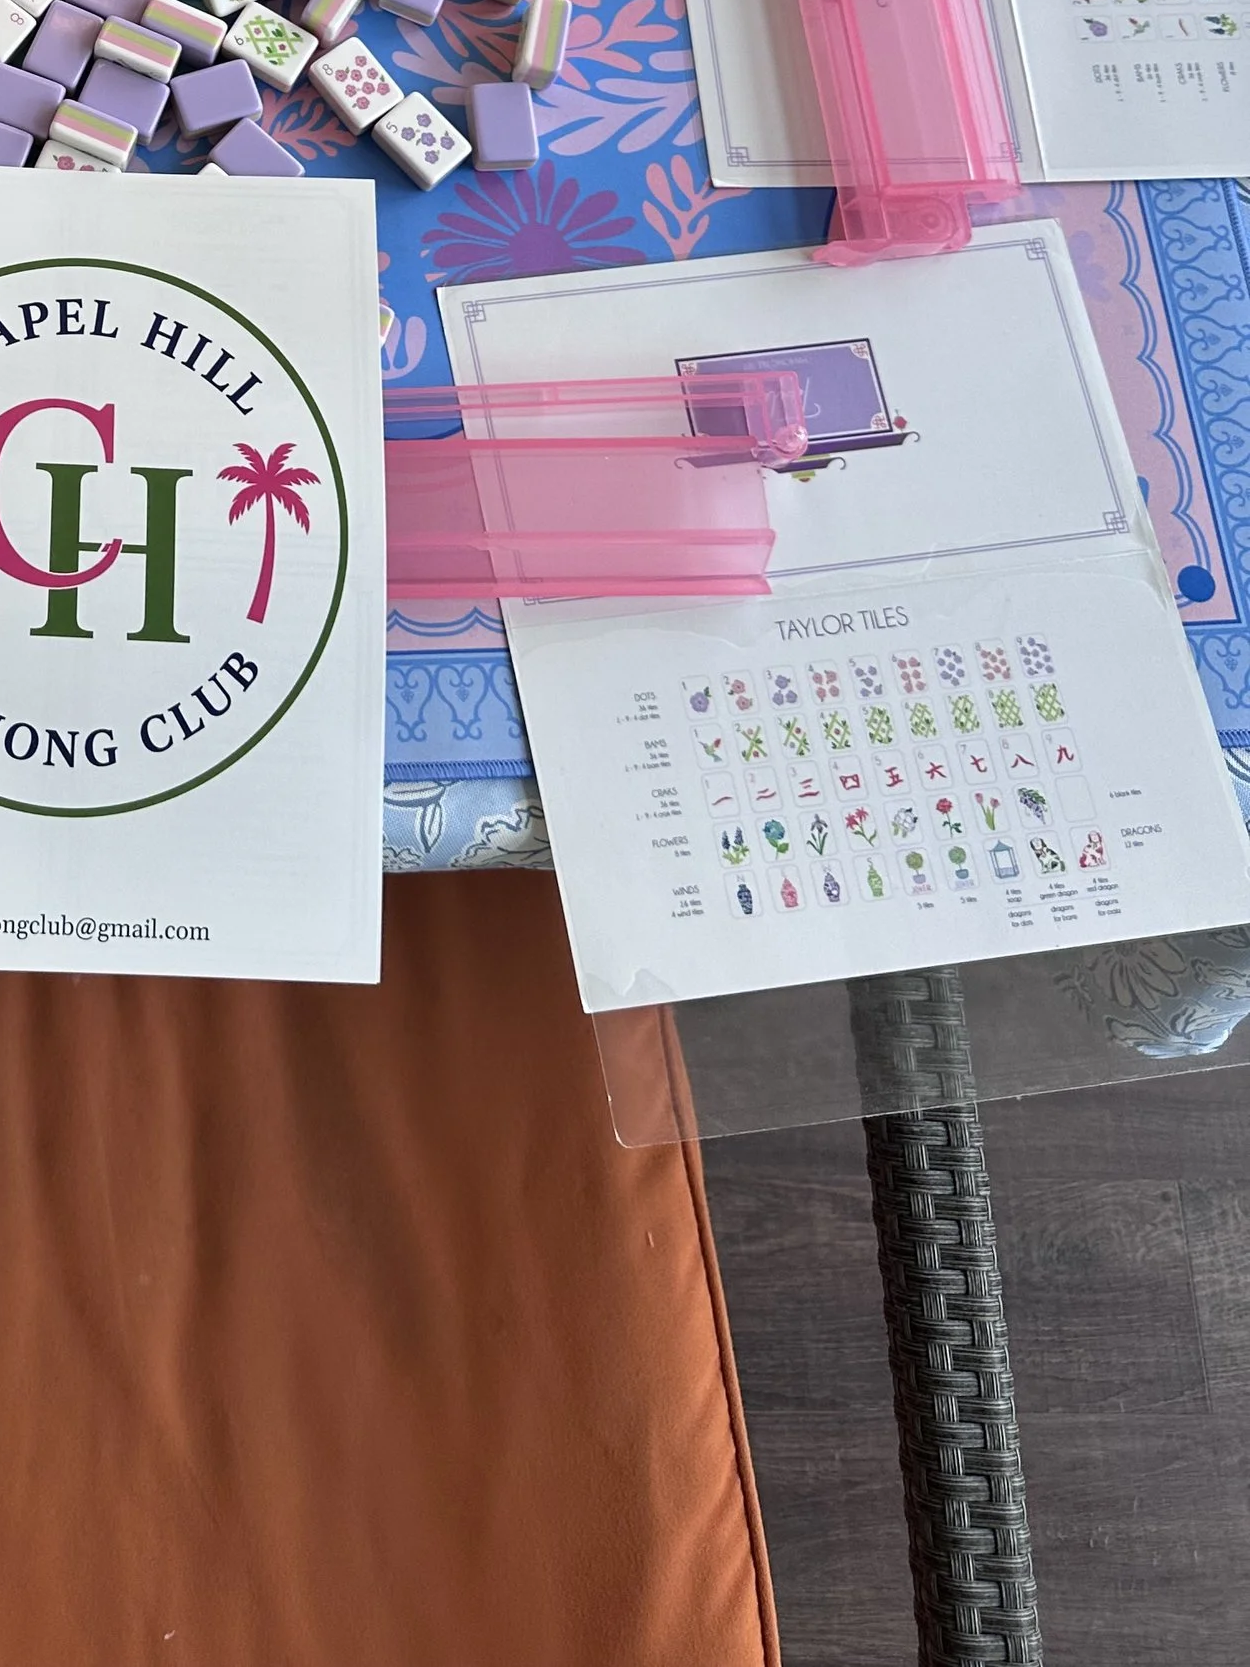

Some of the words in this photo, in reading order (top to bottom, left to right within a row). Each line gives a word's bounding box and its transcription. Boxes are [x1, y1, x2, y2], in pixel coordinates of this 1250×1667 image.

[141, 312, 262, 415] HILL
[775, 613, 854, 639] TAYLOR
[858, 606, 908, 629] TILES
[141, 652, 258, 752] CLUB
[633, 691, 656, 702] DOTS
[644, 739, 667, 749] BAMS
[651, 787, 677, 798] CRAKS
[1120, 824, 1162, 837] DRAGONS
[651, 835, 688, 847] FLOWERS
[672, 885, 699, 895] WINDS
